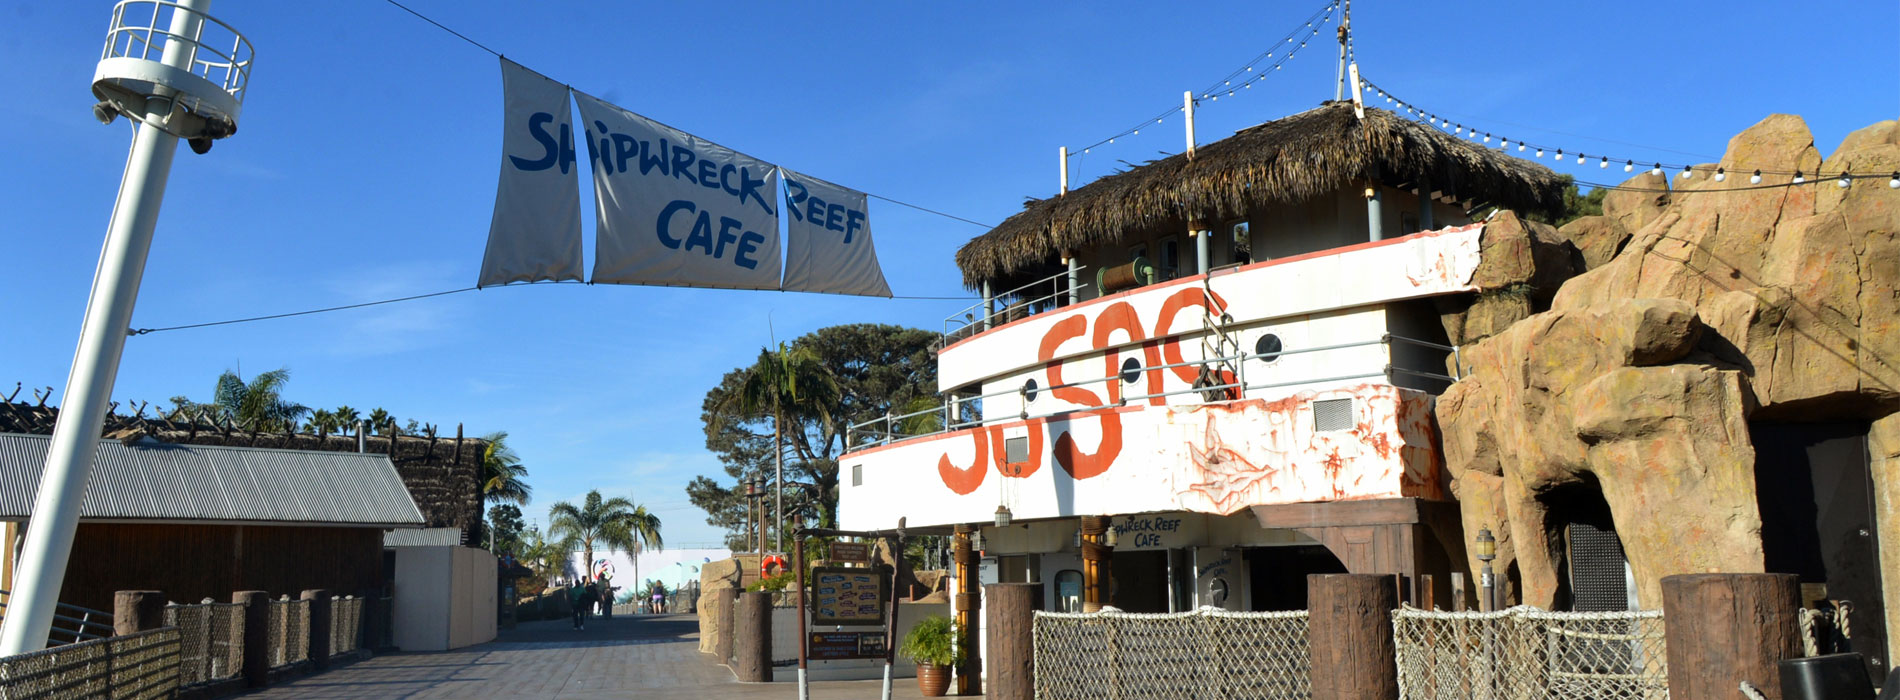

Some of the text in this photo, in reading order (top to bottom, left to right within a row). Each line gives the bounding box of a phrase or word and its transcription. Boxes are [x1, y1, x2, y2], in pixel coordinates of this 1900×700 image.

[776, 178, 866, 244] REEF
[656, 200, 766, 270] CAFE
[1114, 516, 1182, 537] PWRECK REEF
[1134, 533, 1161, 548] CAFE
